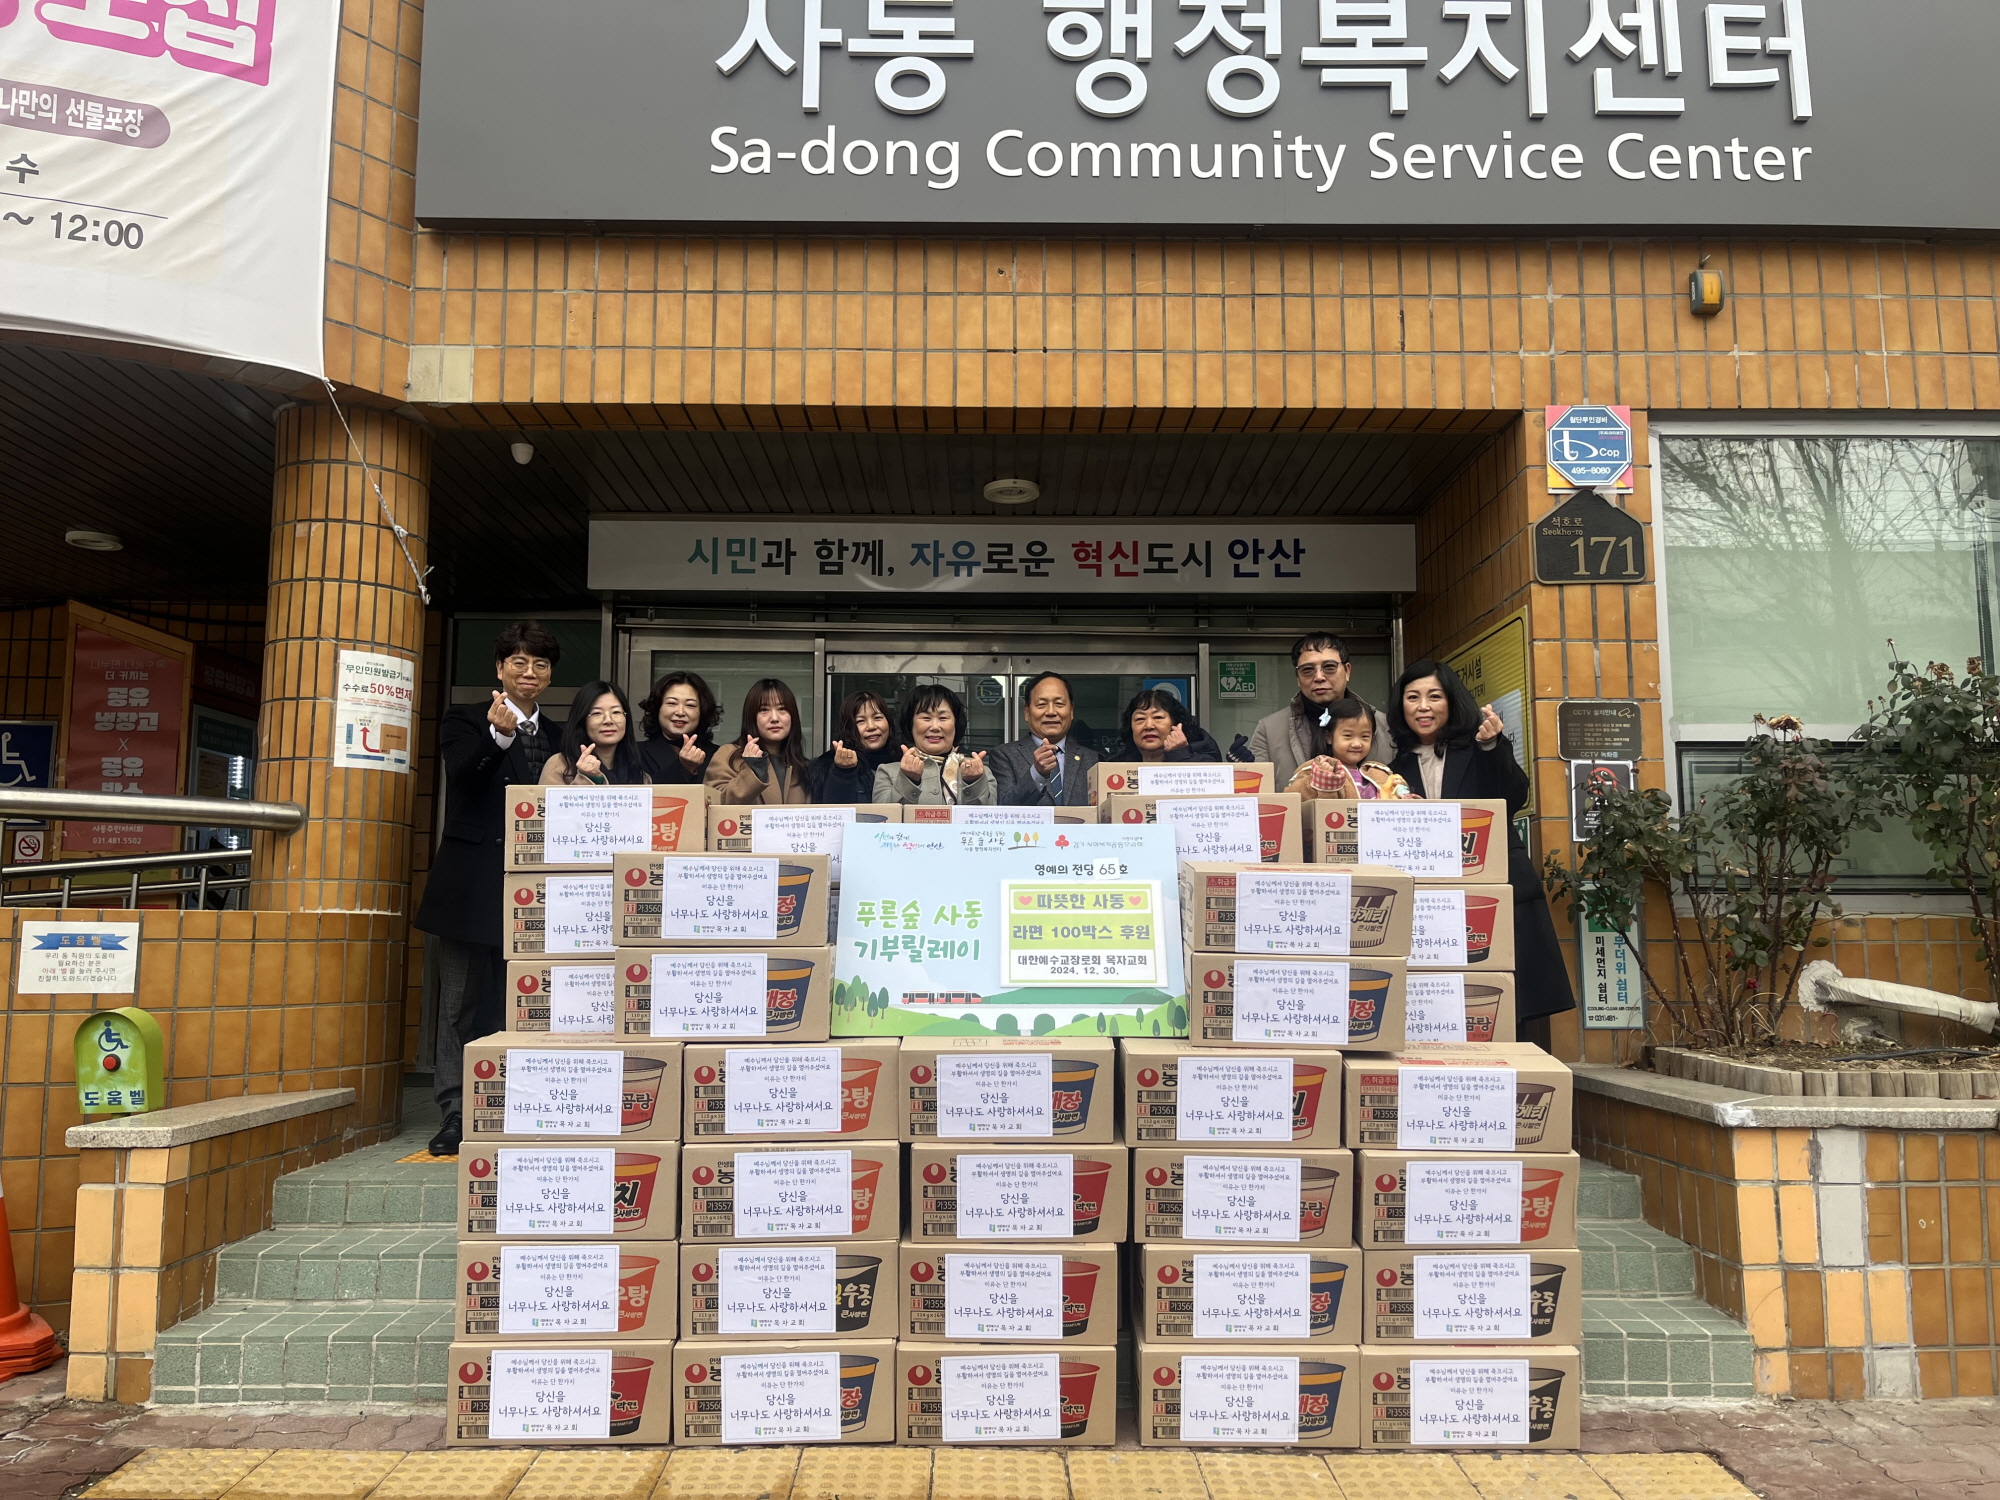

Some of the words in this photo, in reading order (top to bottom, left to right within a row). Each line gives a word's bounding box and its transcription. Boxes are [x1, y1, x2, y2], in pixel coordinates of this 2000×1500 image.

[715, 0, 974, 114] 사동
[1044, 0, 1813, 121] 행정복지센터
[0, 87, 58, 124] 나만의
[65, 98, 144, 138] 선물포장
[710, 125, 960, 190] Sa-dong
[986, 129, 1346, 192] Community
[1369, 131, 1583, 180] Service
[1608, 133, 1812, 181] Center
[6, 153, 39, 184] 수
[50, 211, 144, 250] 12:00
[1599, 447, 1619, 457] Cop
[1551, 516, 1584, 527] 석호로
[1543, 528, 1583, 537] Seokho-ro
[687, 537, 796, 578] 시민과
[814, 537, 895, 579] 함께,
[909, 537, 1055, 578] 자유로운
[1072, 537, 1212, 579] 혁신도시
[1226, 537, 1306, 579] 안산
[1570, 536, 1639, 575] 171
[105, 671, 115, 680] 더
[119, 671, 149, 681] 커지는
[345, 664, 403, 681] 무인민원발급기
[1235, 682, 1255, 692] AED
[107, 687, 150, 707] 공유
[94, 712, 159, 732] 냉장고
[101, 757, 144, 777] 공유
[92, 825, 144, 834] 사동주민자치회
[92, 837, 142, 845] 031.481.5502
[1035, 863, 1068, 875] 영예의
[1072, 863, 1094, 875] 전당
[707, 895, 734, 906] 당신을
[1037, 893, 1085, 909] 따뜻한
[1092, 893, 1125, 909] 사동
[671, 909, 709, 919] 너무나도
[713, 909, 769, 920] 사랑하셔서요
[856, 900, 921, 929] 푸른숲
[933, 900, 983, 929] 사동
[1279, 911, 1307, 921] 당신을
[1013, 925, 1043, 940] 라면
[1051, 925, 1113, 940] 100박스
[1120, 925, 1150, 940] 후원
[1245, 924, 1282, 934] 너무나도
[1286, 925, 1341, 935] 사랑하셔서요
[854, 934, 980, 963] 기부릴레이
[1595, 936, 1606, 980] 미세먼지
[1614, 935, 1627, 974] 무더위
[1018, 955, 1101, 966] 대한예수교장로회
[1106, 955, 1148, 966] 목자교회
[1050, 966, 1079, 975] 2024.
[1084, 966, 1100, 975] 12.
[1103, 966, 1120, 975] 30.
[1597, 982, 1608, 1004] 쉼터
[1616, 978, 1628, 1004] 쉼터
[550, 1089, 578, 1100] 당신을
[981, 1093, 1009, 1103] 당신을
[622, 1092, 653, 1110] 곰탕
[1221, 1096, 1249, 1107] 당신을
[514, 1103, 552, 1113] 너무나도
[556, 1103, 612, 1114] 사랑하셔서요
[946, 1107, 984, 1117] 너무나도
[988, 1106, 1044, 1117] 사랑하셔서요
[1150, 1105, 1176, 1115] 가3561
[1186, 1110, 1224, 1120] 너무나도
[1228, 1110, 1284, 1121] 사랑하셔서요
[542, 1188, 570, 1199] 당신을
[506, 1202, 544, 1213] 너무나도
[548, 1202, 605, 1213] 사랑하셔서요
[708, 1201, 731, 1211] 가3557
[1450, 1200, 1477, 1210] 당신을
[1414, 1214, 1452, 1224] 너무나도
[1456, 1213, 1512, 1224] 사랑하셔서요
[536, 1391, 565, 1402] 당신을
[987, 1394, 1015, 1406] 당신을
[1456, 1399, 1484, 1410] 당신을
[499, 1406, 538, 1417] 너무나도
[543, 1406, 601, 1417] 사랑하셔서요
[951, 1409, 990, 1420] 너무나도
[994, 1408, 1051, 1419] 사랑하셔서요
[1420, 1414, 1458, 1424] 너무나도
[1463, 1413, 1520, 1424] 사랑하셔서요
